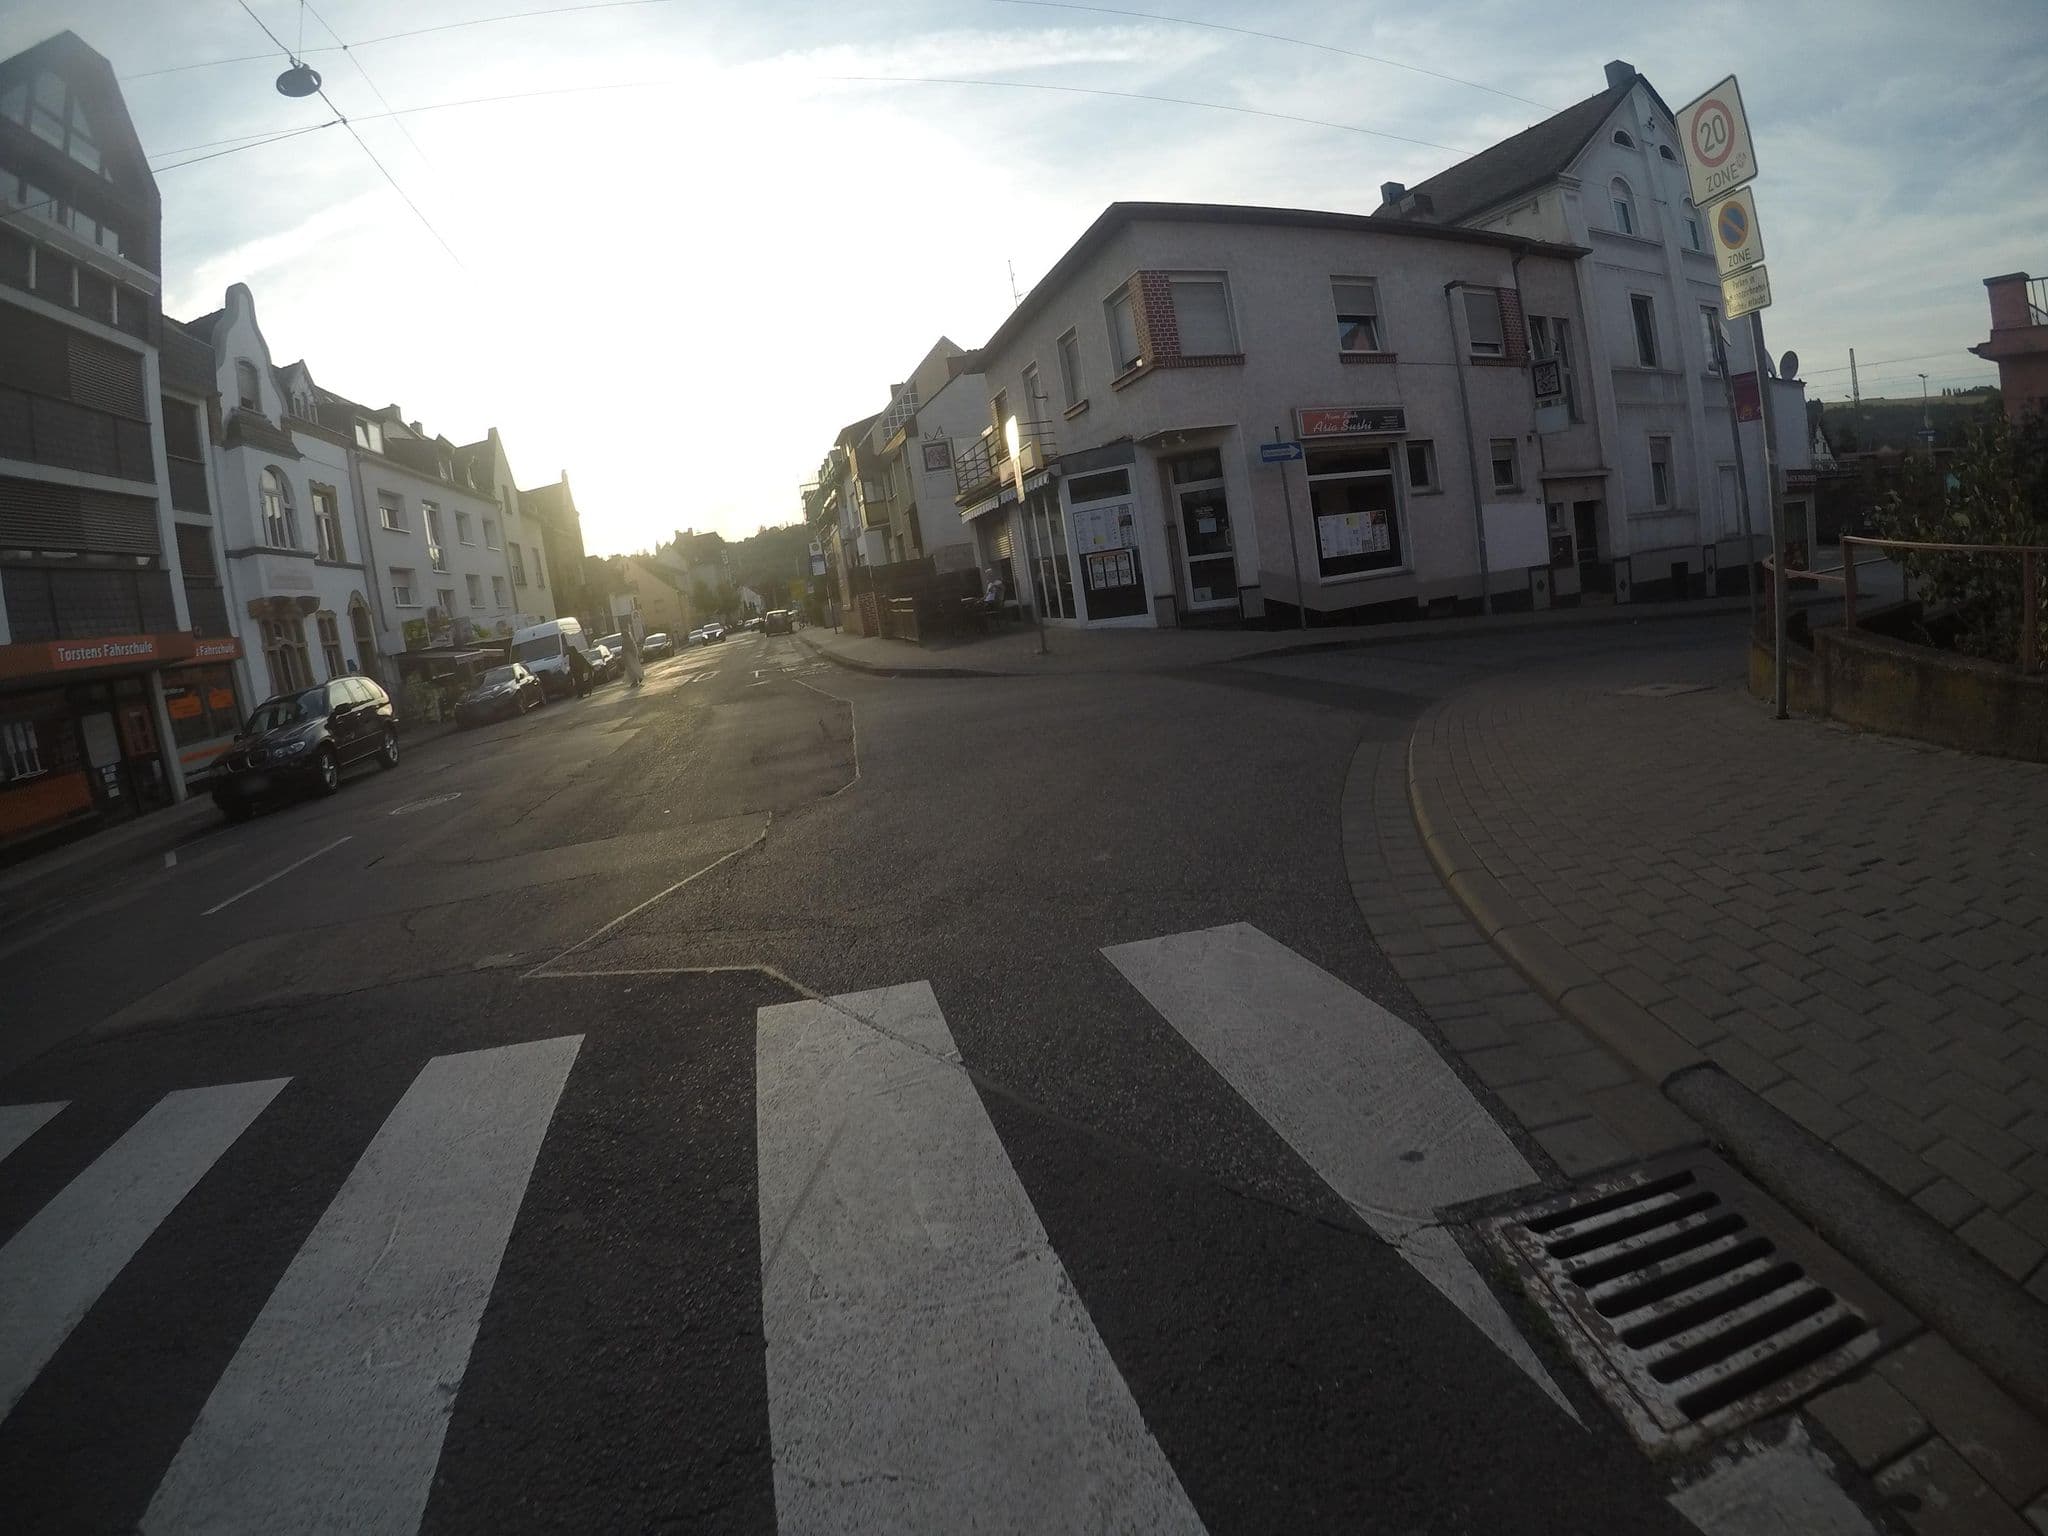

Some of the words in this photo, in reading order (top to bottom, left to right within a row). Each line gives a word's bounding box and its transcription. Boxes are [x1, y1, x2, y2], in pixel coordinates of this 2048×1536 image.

[1700, 114, 1726, 152] 20
[1705, 163, 1739, 192] ZONE
[1728, 248, 1752, 267] ZONE
[1313, 421, 1338, 433] Asia
[1341, 418, 1372, 431] Sushi
[57, 646, 102, 662] Torstens
[103, 640, 153, 657] Fahrschule
